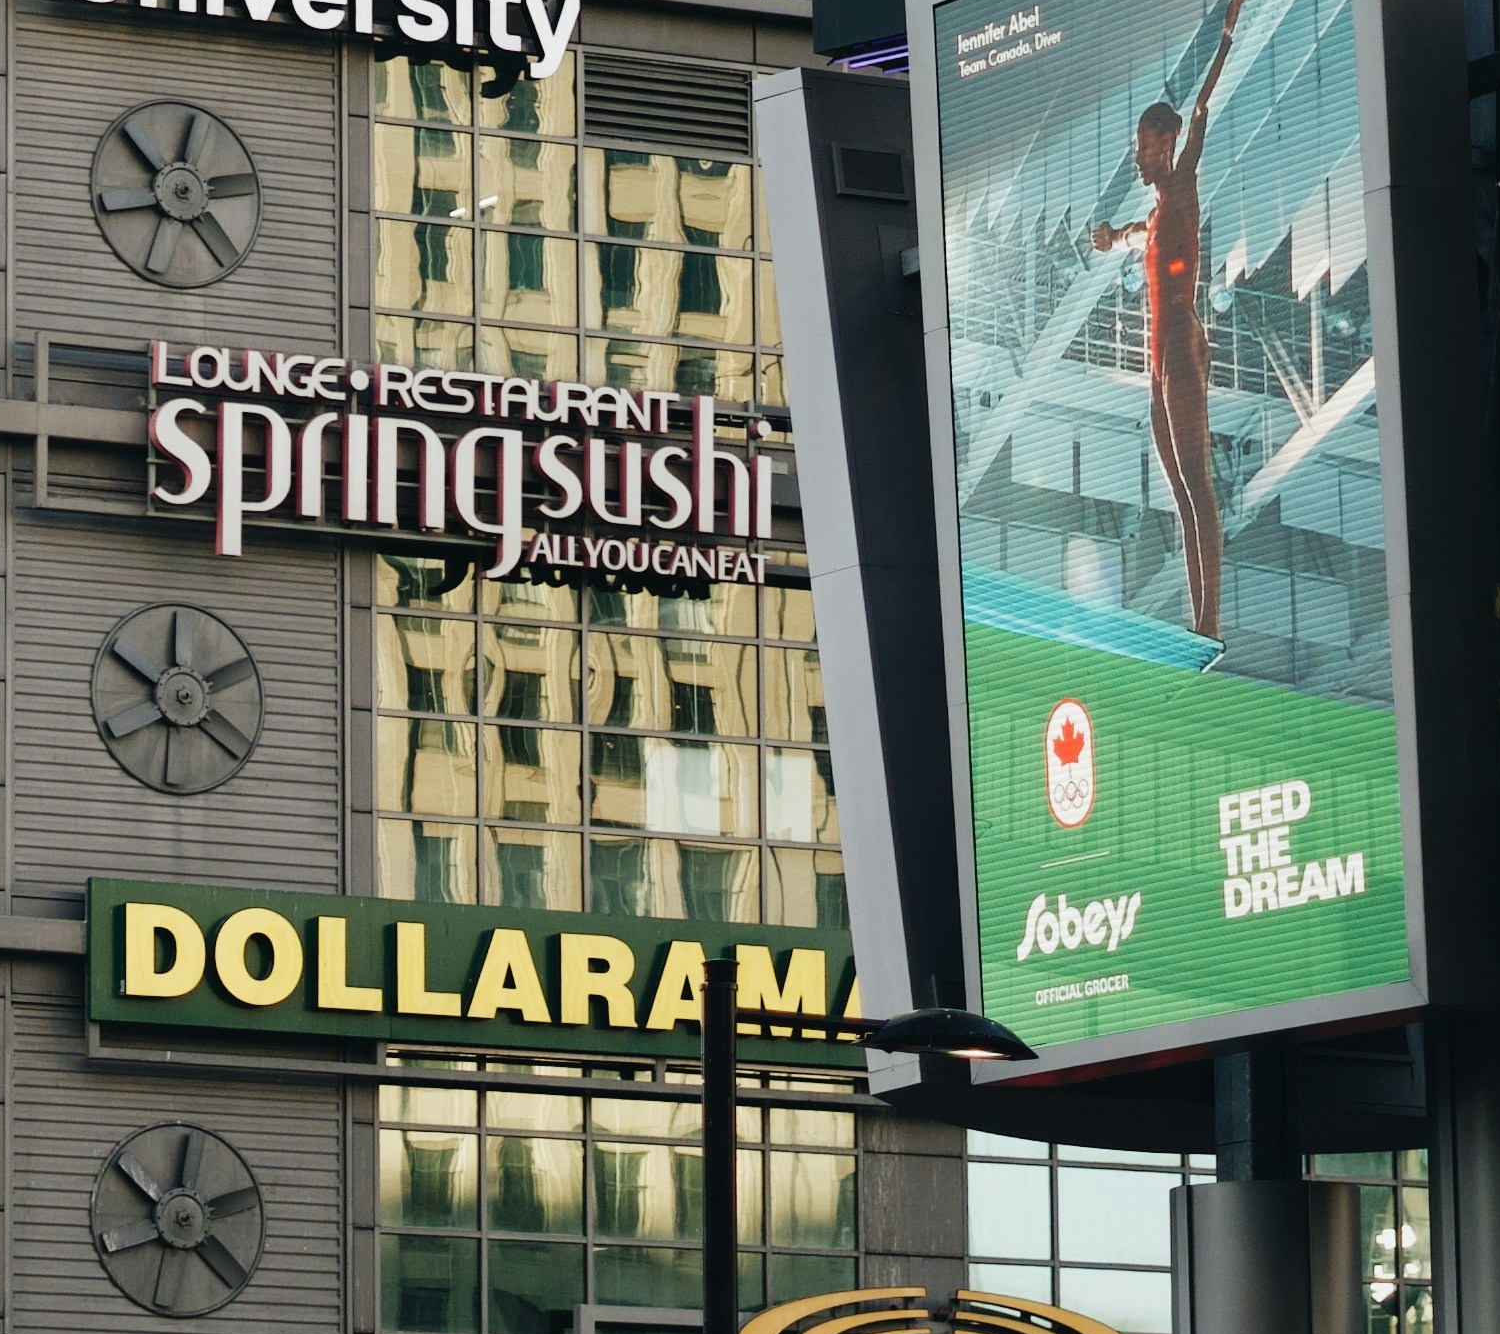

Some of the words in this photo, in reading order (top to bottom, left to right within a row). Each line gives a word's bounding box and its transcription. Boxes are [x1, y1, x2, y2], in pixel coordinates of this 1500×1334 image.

[957, 22, 1006, 55] Jennifer
[1008, 5, 1040, 37] Abel
[958, 60, 987, 78] Team
[988, 39, 1033, 67] Canada,
[1034, 30, 1062, 51] Diver
[153, 342, 347, 401] LOUNGE
[376, 363, 680, 434] RESTAURANT
[1218, 780, 1312, 836] FEED
[1218, 825, 1292, 877] THE
[1222, 851, 1366, 920] DREAM
[1015, 891, 1142, 964] Sobeys
[122, 901, 861, 1041] DOLLARAM
[1034, 978, 1084, 1005] OFFICIAL
[1084, 973, 1130, 999] GROCER
